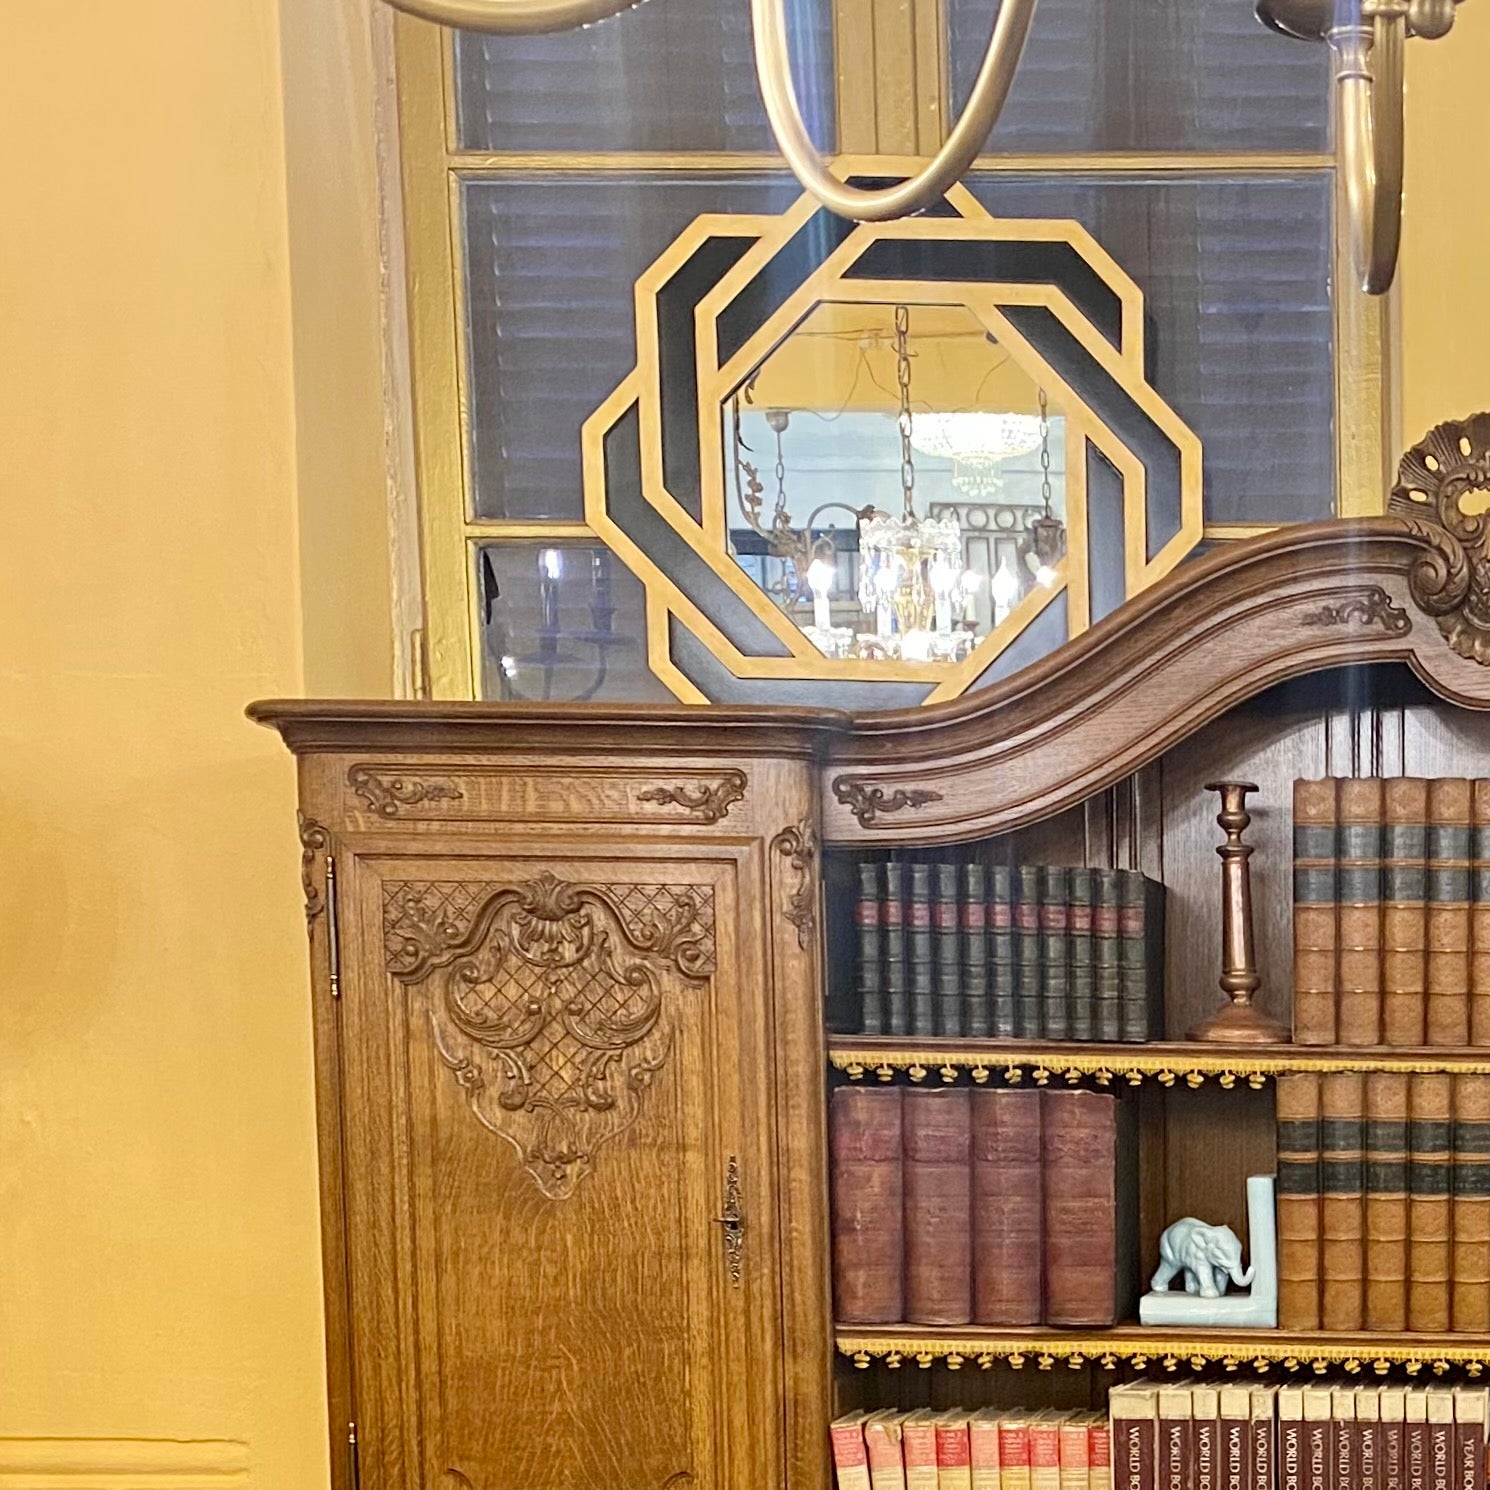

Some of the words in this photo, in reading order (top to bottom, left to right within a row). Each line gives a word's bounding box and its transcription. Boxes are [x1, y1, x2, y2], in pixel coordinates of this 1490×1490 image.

[1129, 1427, 1141, 1473] WORLD
[1170, 1426, 1181, 1473] WORLD
[1199, 1427, 1211, 1473] WORLD
[1229, 1427, 1240, 1473] WORLD
[1256, 1427, 1268, 1473] WORLD
[1286, 1428, 1298, 1474] WORLD
[1312, 1428, 1323, 1474] WORLD
[1339, 1429, 1350, 1475] WORLD
[1362, 1429, 1373, 1475] WORLD
[1410, 1430, 1422, 1476] WORLD
[1434, 1431, 1446, 1477] WORLD
[1463, 1439, 1475, 1468] YEAR
